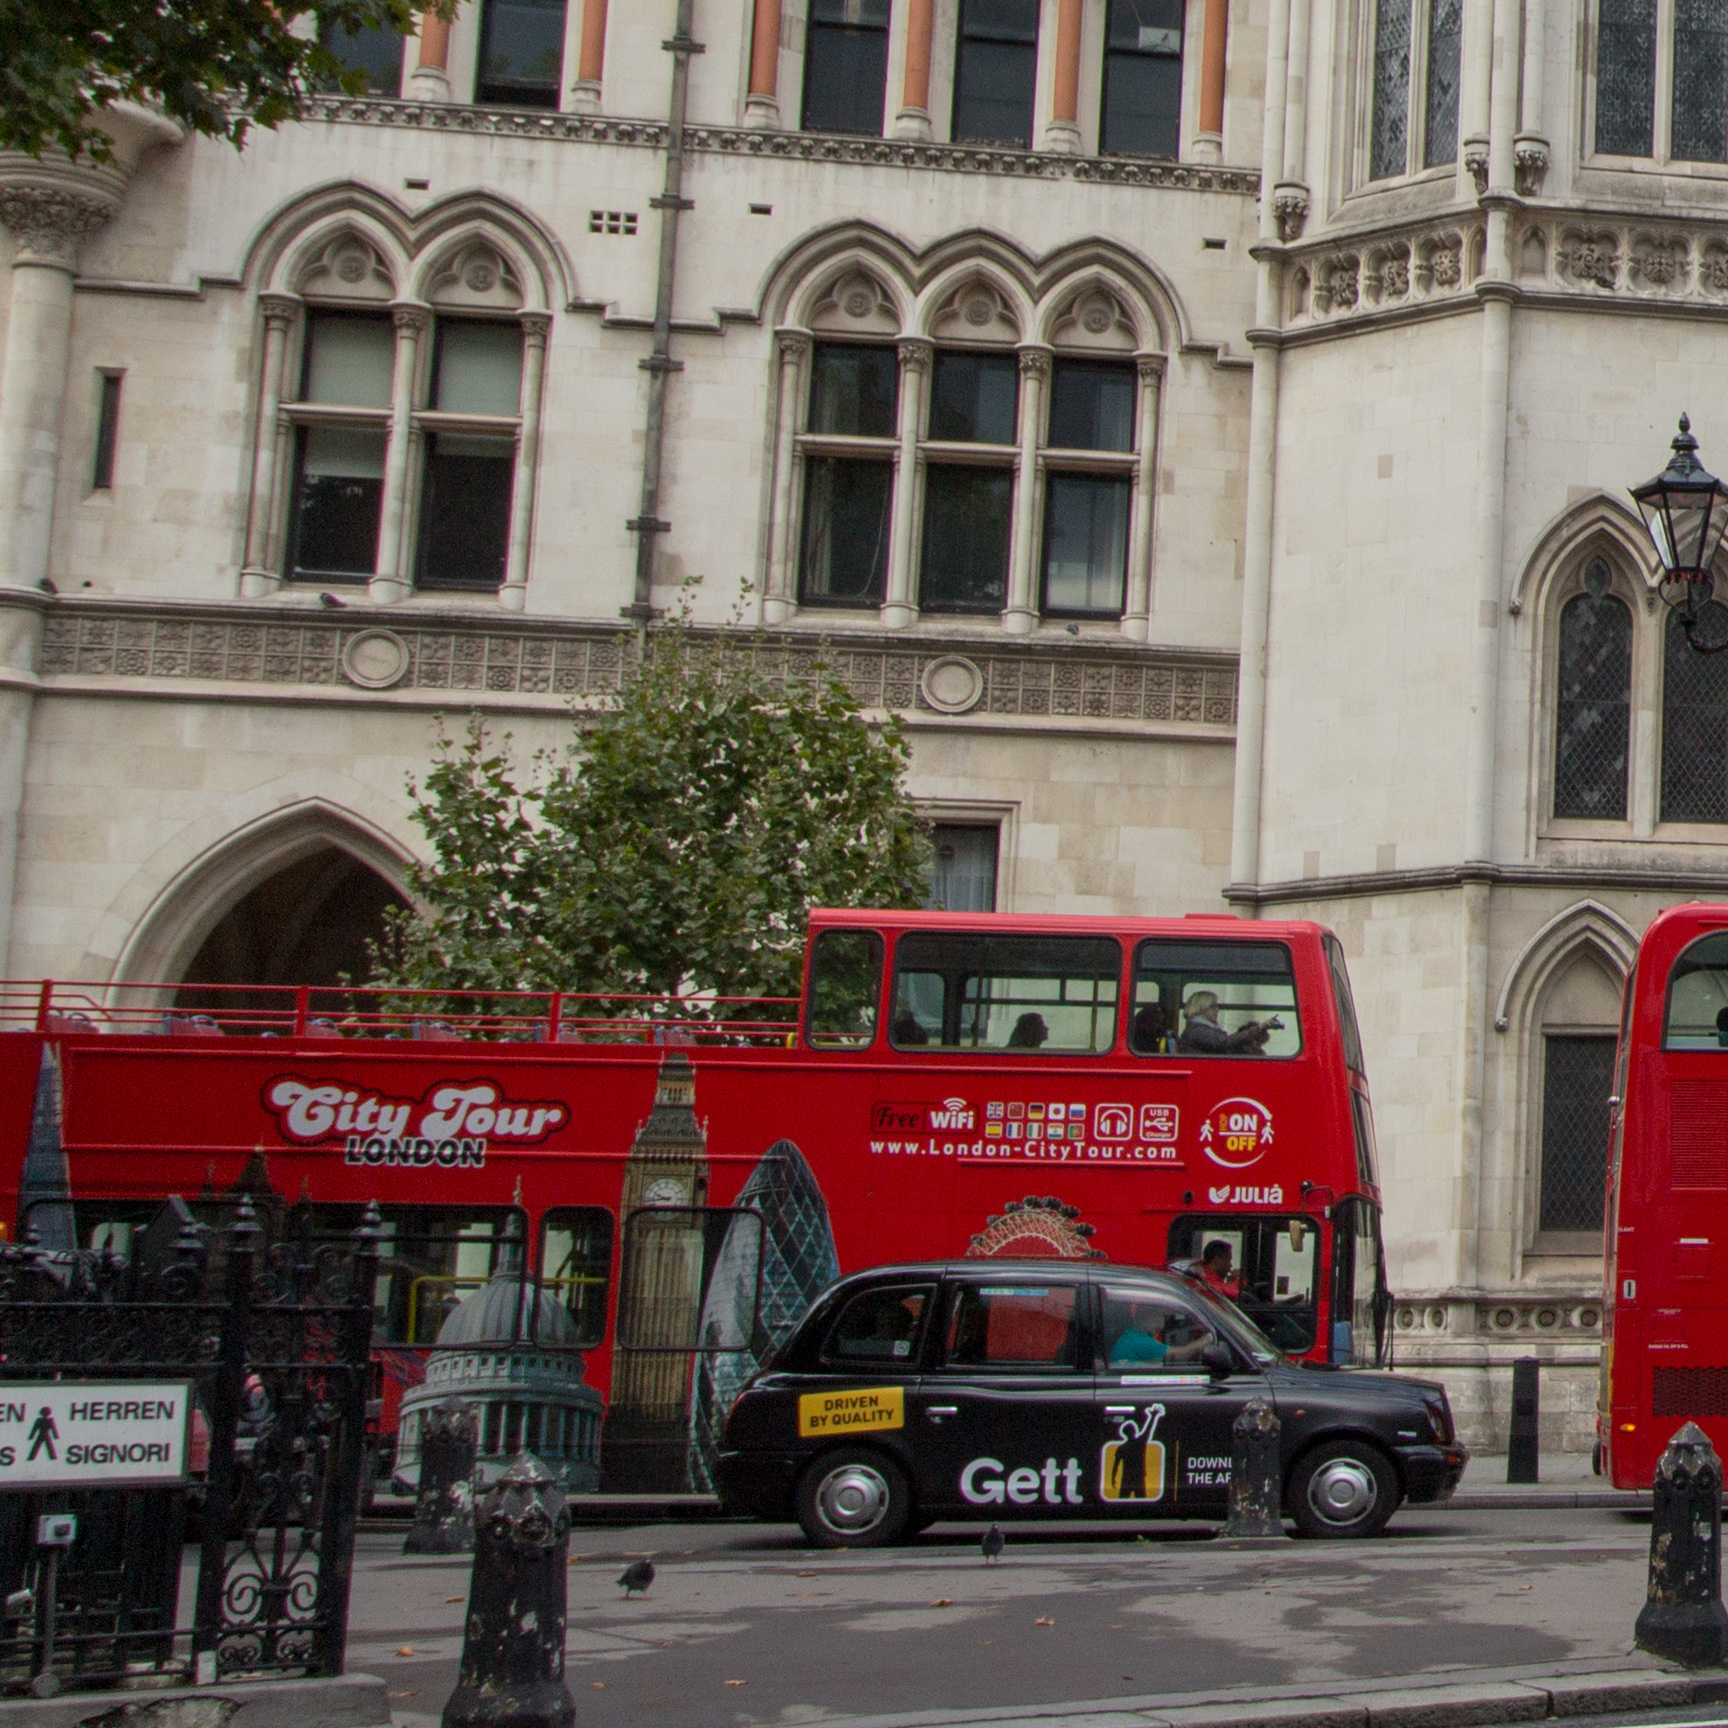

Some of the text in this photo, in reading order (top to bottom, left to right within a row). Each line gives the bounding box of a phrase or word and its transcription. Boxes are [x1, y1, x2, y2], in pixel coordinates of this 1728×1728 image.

[272, 1081, 562, 1140] City Tour
[930, 1110, 975, 1130] WiFi
[1150, 1108, 1170, 1117] USB
[1229, 1113, 1258, 1131] ON
[344, 1136, 488, 1168] LONDON
[870, 1139, 1177, 1161] www.London-CityTour.com
[1226, 1135, 1257, 1151] OFF
[70, 1400, 175, 1421] HERREN
[824, 1396, 879, 1411] DRIVEN
[810, 1409, 894, 1428] BY QUALITY
[66, 1442, 171, 1465] SIGNORI
[960, 1457, 1083, 1504] Gett
[1187, 1473, 1213, 1485] THE
